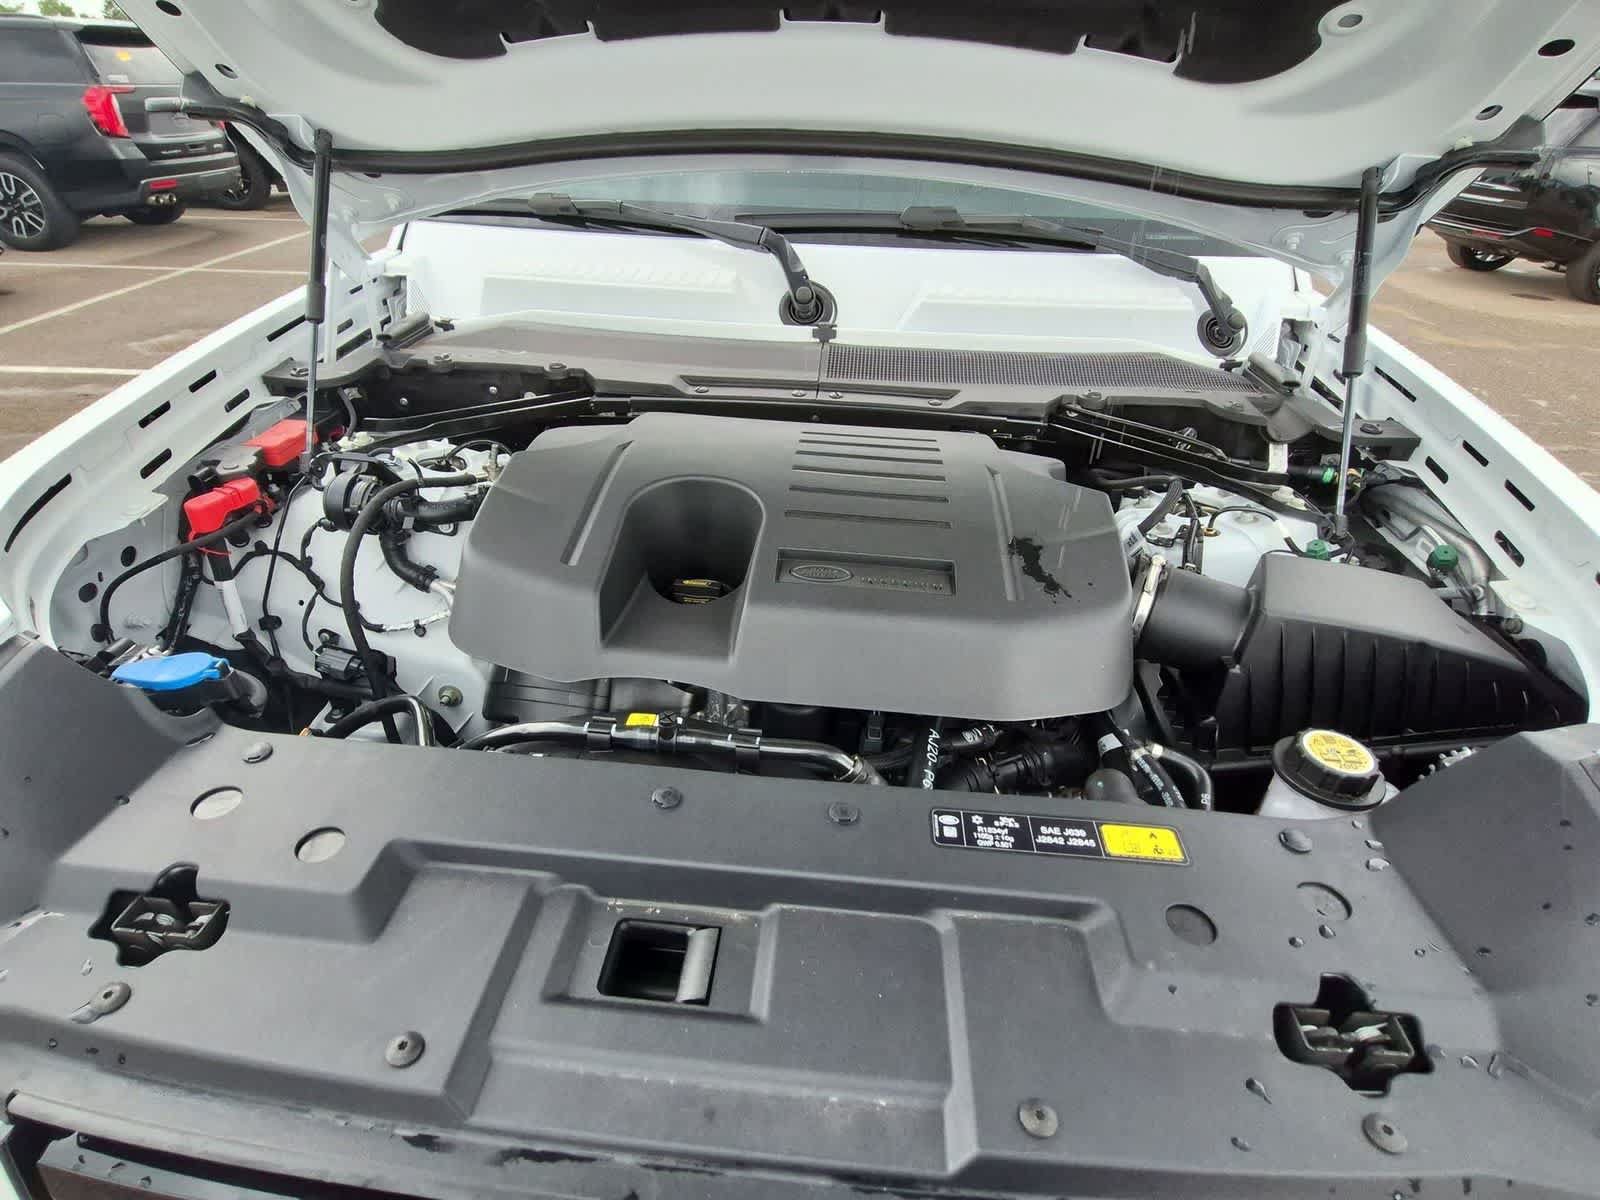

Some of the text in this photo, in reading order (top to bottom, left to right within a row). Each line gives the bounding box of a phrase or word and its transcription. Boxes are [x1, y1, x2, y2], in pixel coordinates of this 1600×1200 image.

[1040, 826, 1087, 837] SAE J639
[1036, 835, 1096, 847] J2842 J2845
